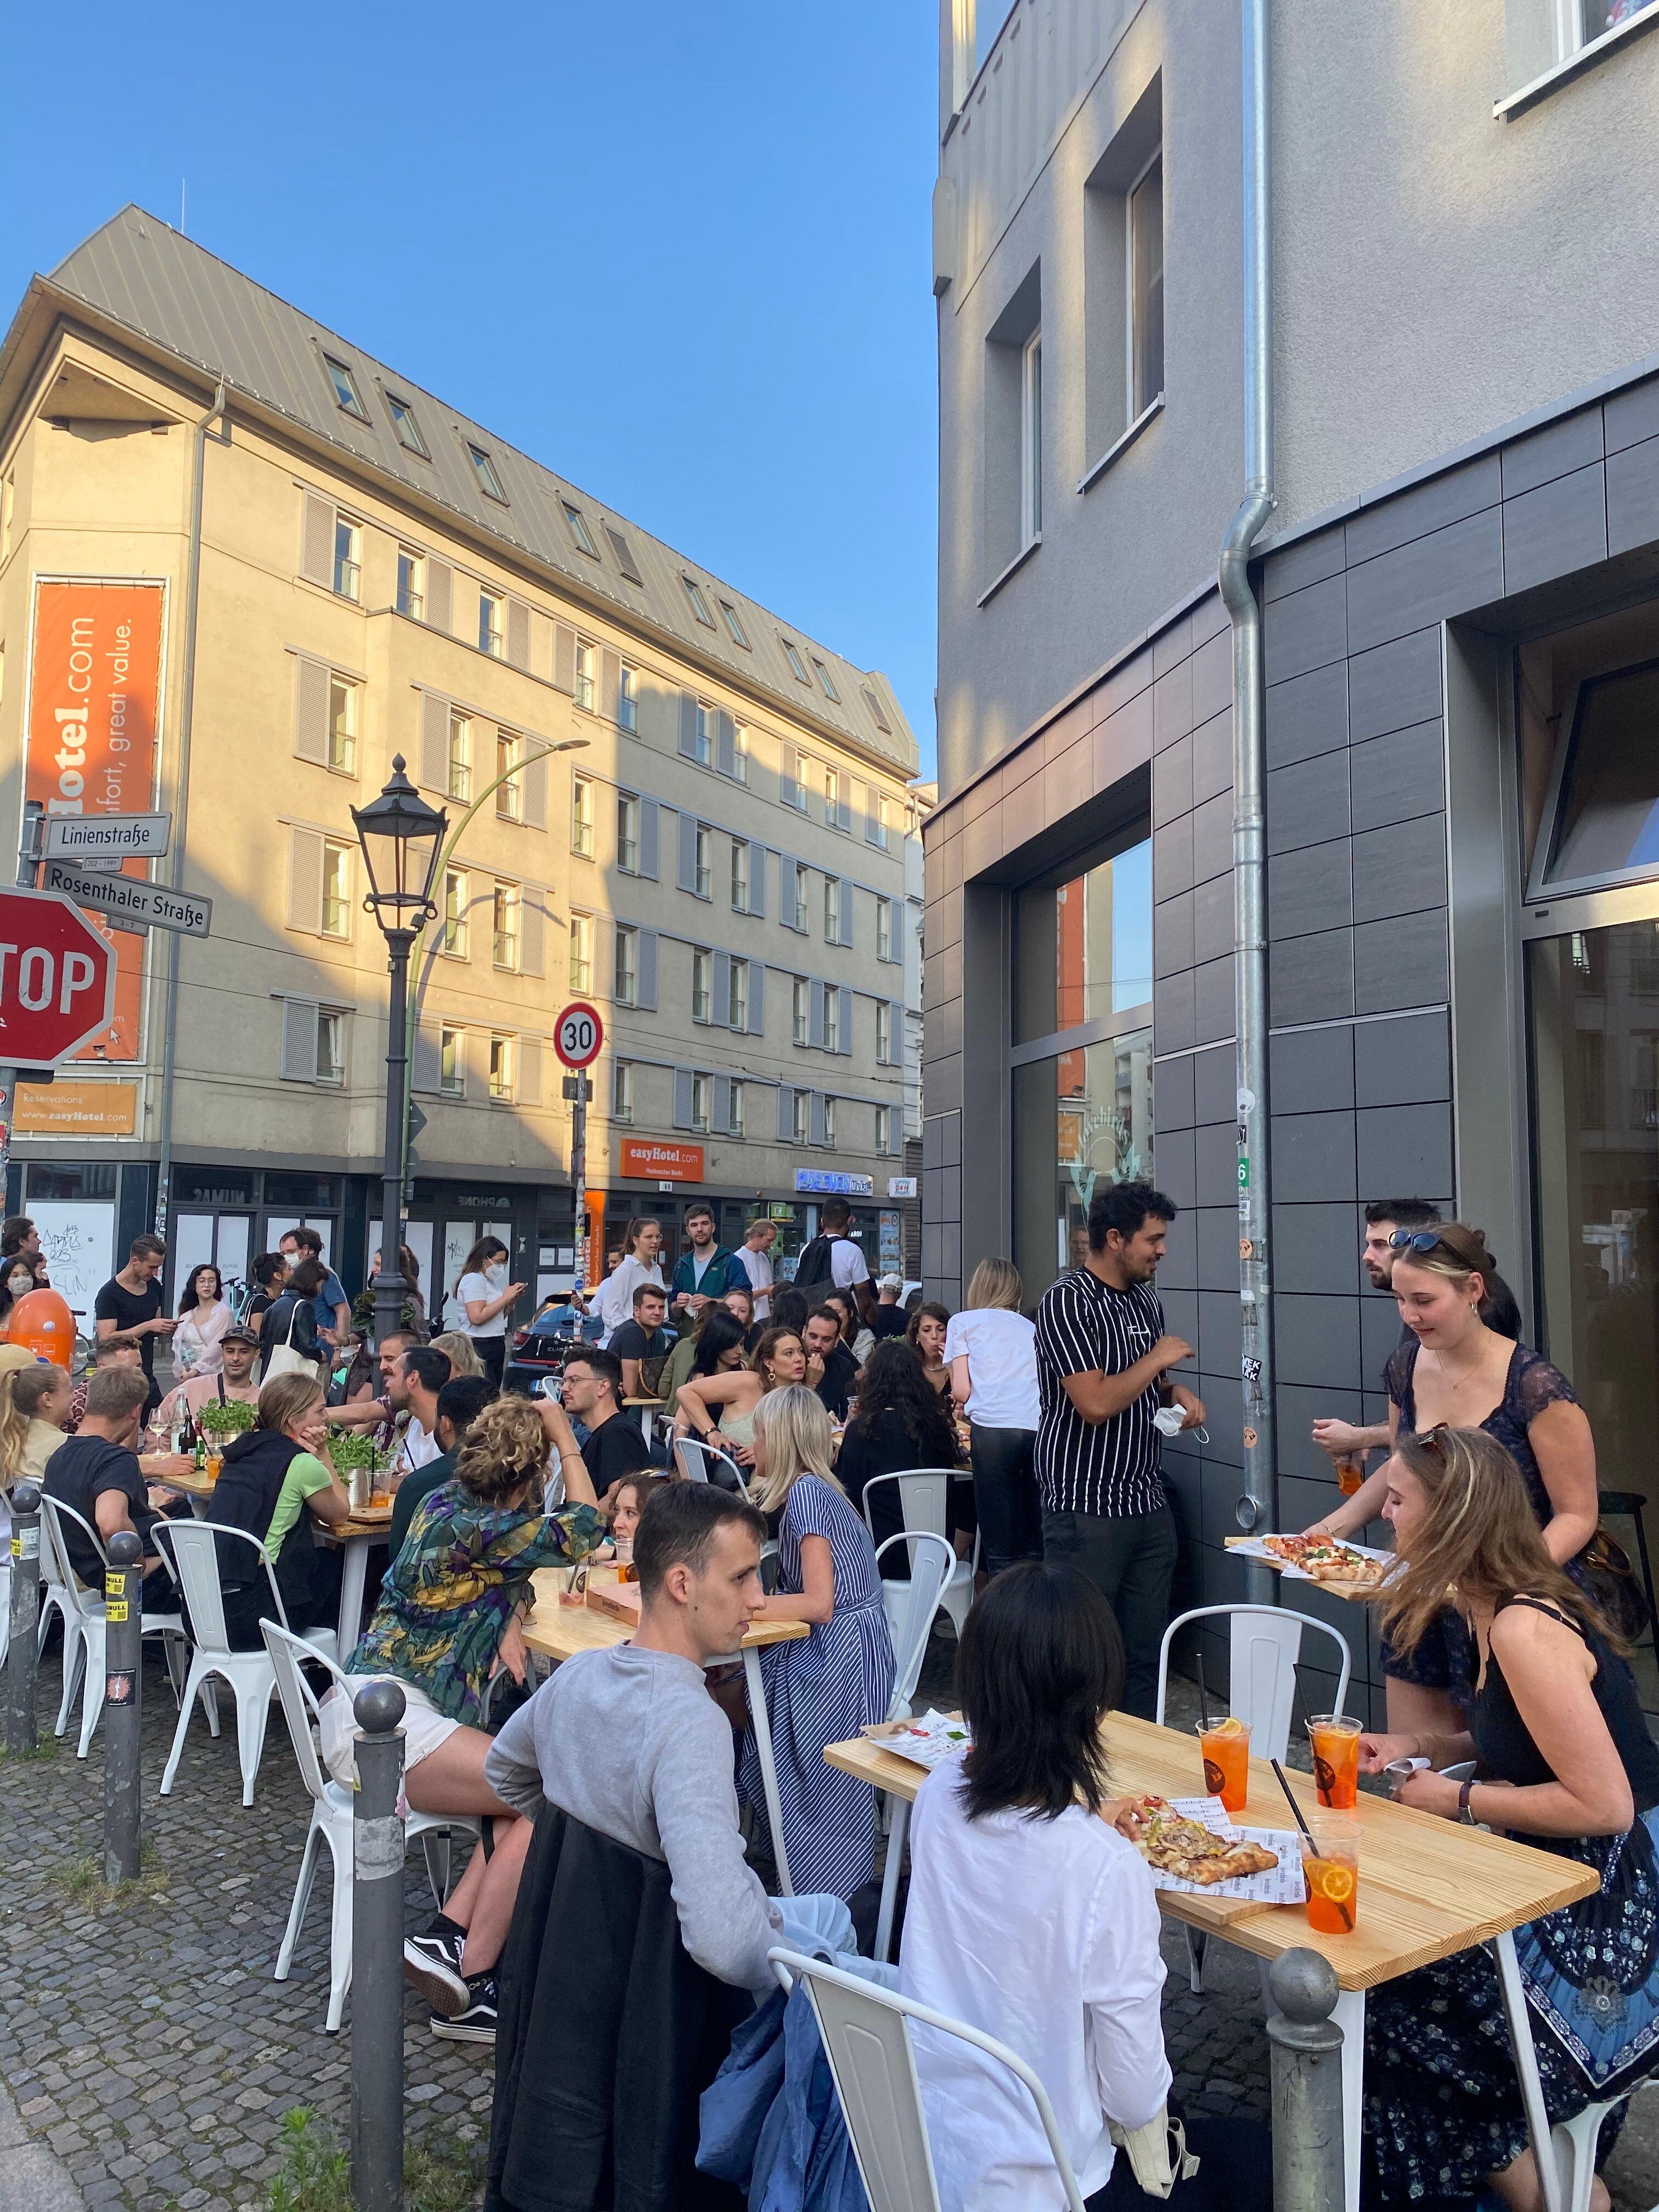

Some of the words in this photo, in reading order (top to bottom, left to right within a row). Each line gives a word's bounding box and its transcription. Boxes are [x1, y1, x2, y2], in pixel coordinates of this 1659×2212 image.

[105, 619, 132, 685] value.
[107, 692, 131, 752] great
[61, 824, 150, 847] Linienstraße
[50, 867, 148, 910] Rosenthaler
[153, 896, 203, 927] Straße
[564, 1020, 592, 1052] 30
[21, 1111, 127, 1121] www.easyHotel.com
[630, 1147, 698, 1164] easyHotel.com
